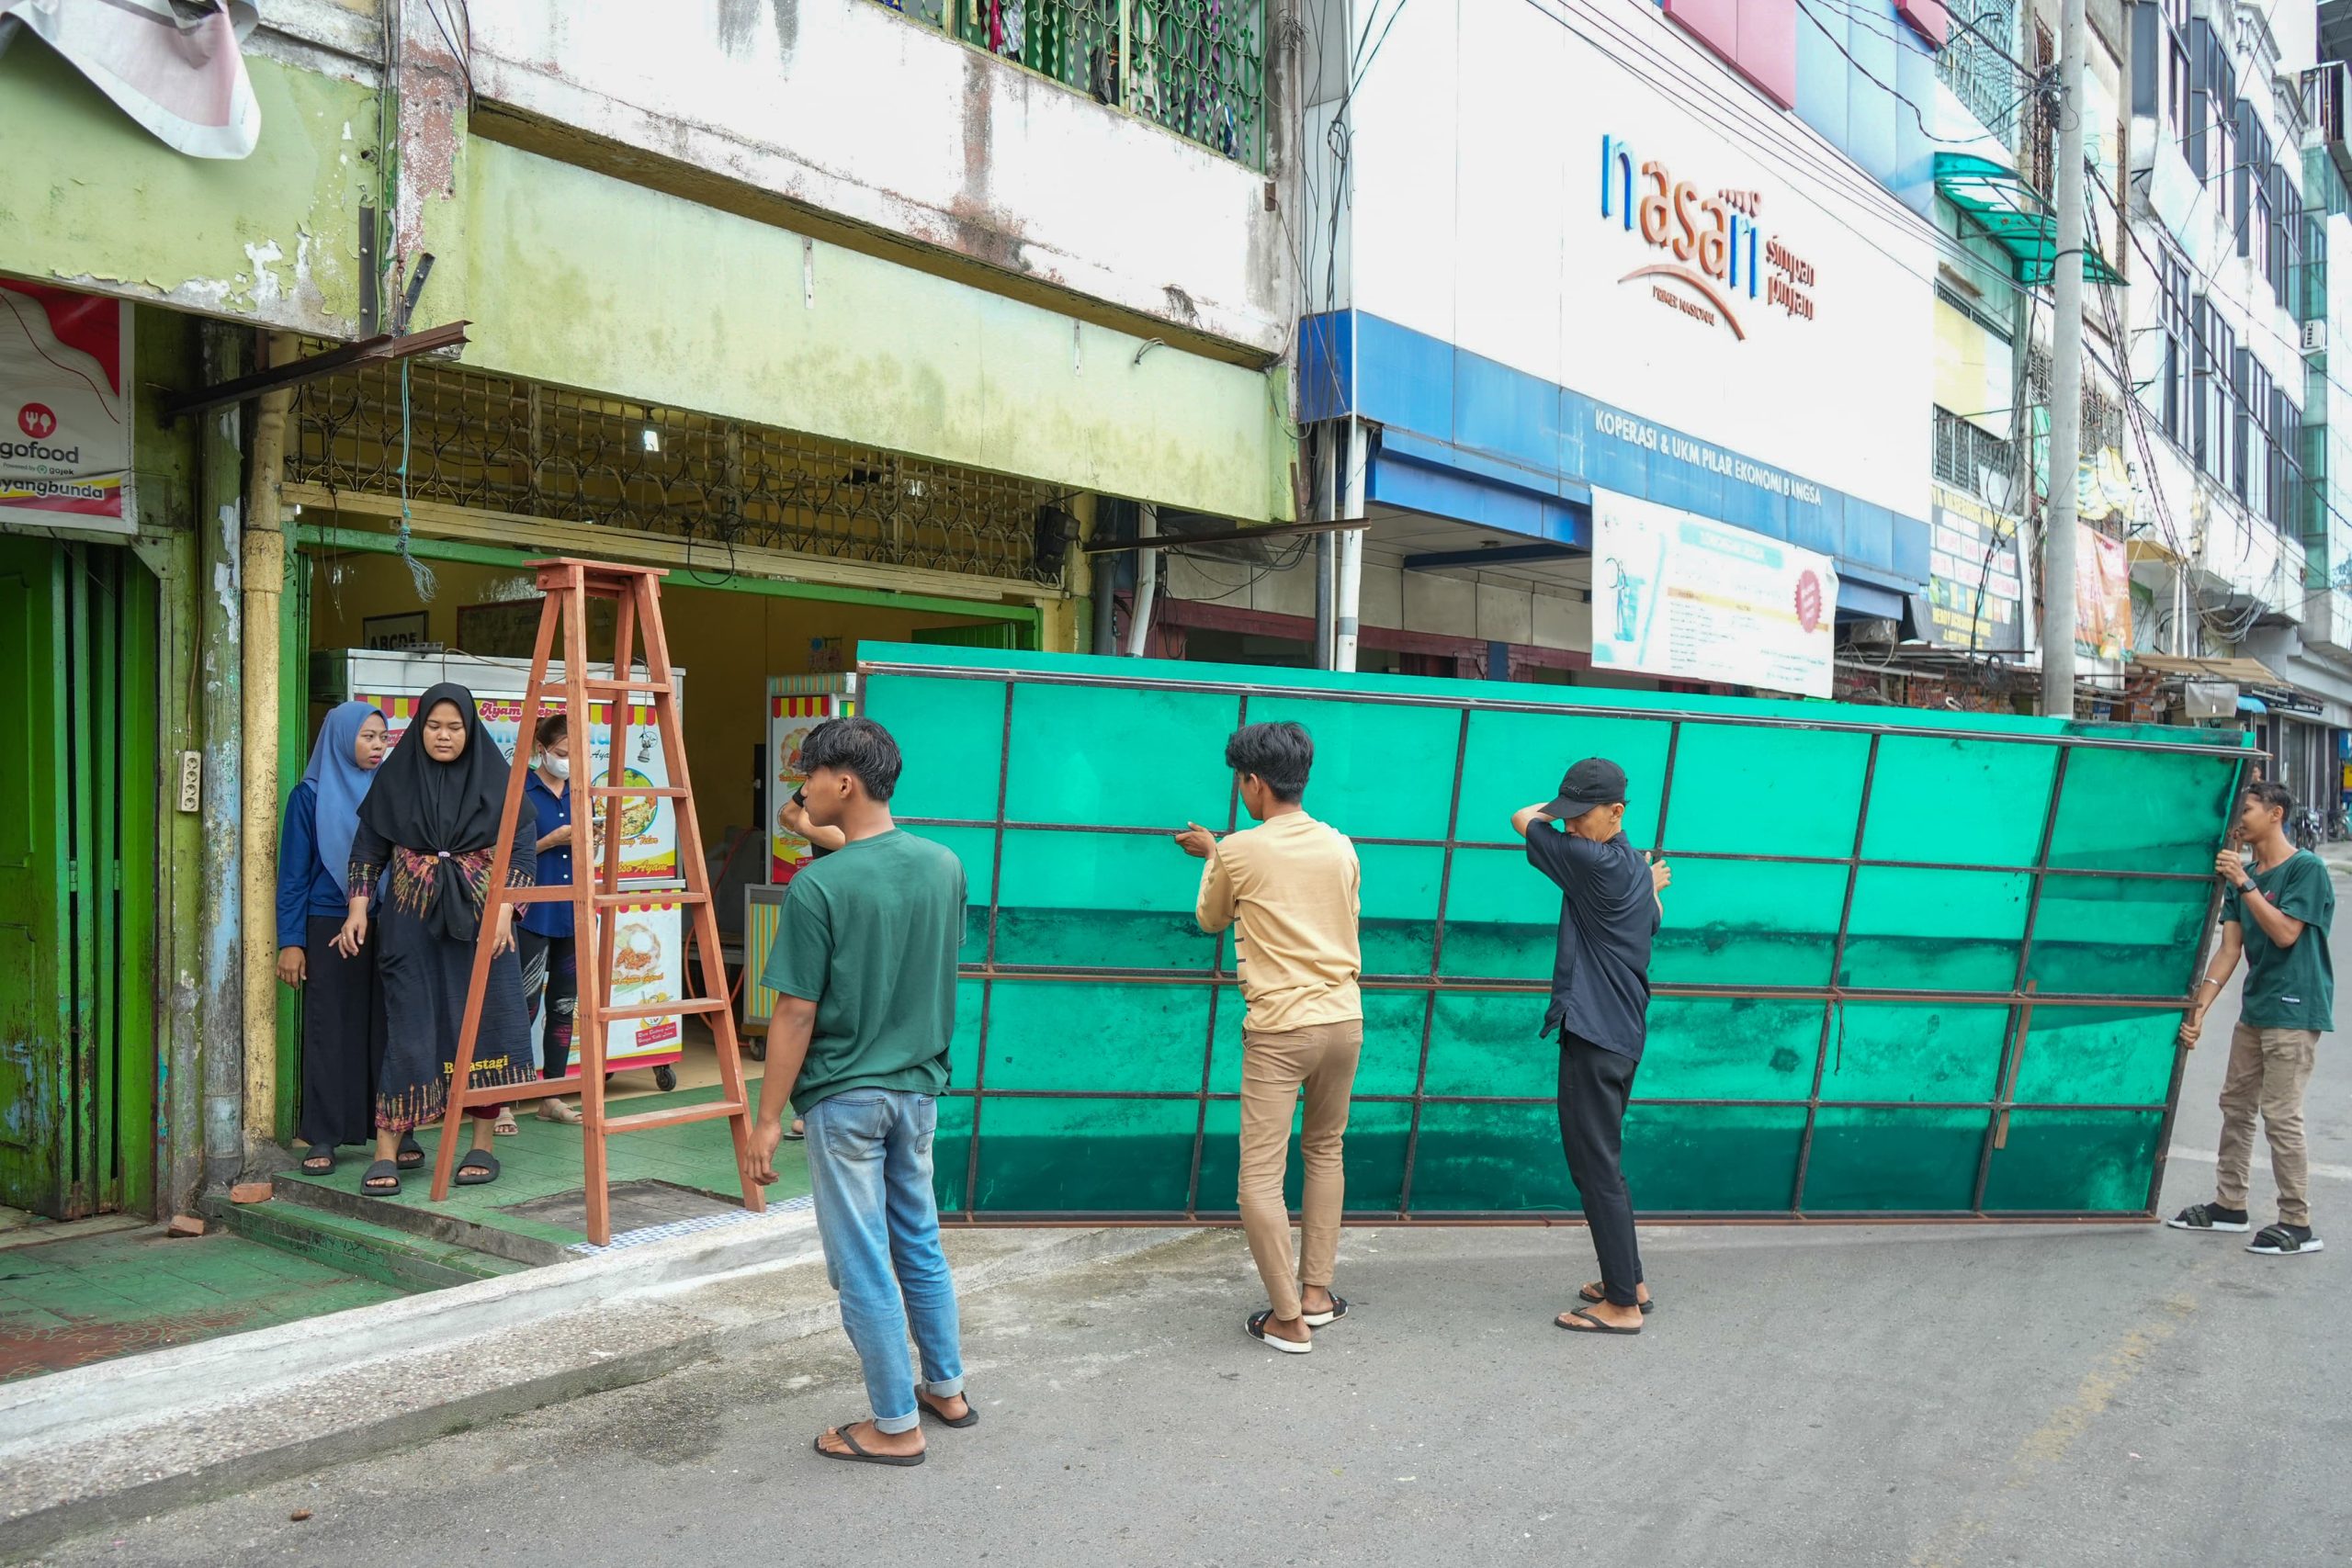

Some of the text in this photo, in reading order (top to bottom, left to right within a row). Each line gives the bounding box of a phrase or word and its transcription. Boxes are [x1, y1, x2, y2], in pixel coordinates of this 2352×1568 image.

[1601, 134, 1757, 299] nasari
[1766, 235, 1814, 288] simpan
[1768, 272, 1814, 321] pinjam
[0, 442, 79, 464] gofood
[1595, 409, 1657, 451] KOPERASI
[1660, 433, 1669, 456] &
[1672, 435, 1700, 467] UKM
[1702, 447, 1733, 478] PILAR
[1735, 459, 1781, 494] EKONOMI
[3, 462, 28, 471] Powered
[50, 468, 74, 476] gojek
[0, 479, 104, 499] yangbunda
[479, 701, 567, 718] Ayam epre
[634, 860, 669, 874] Ayam
[443, 1054, 509, 1075] Bastagi
